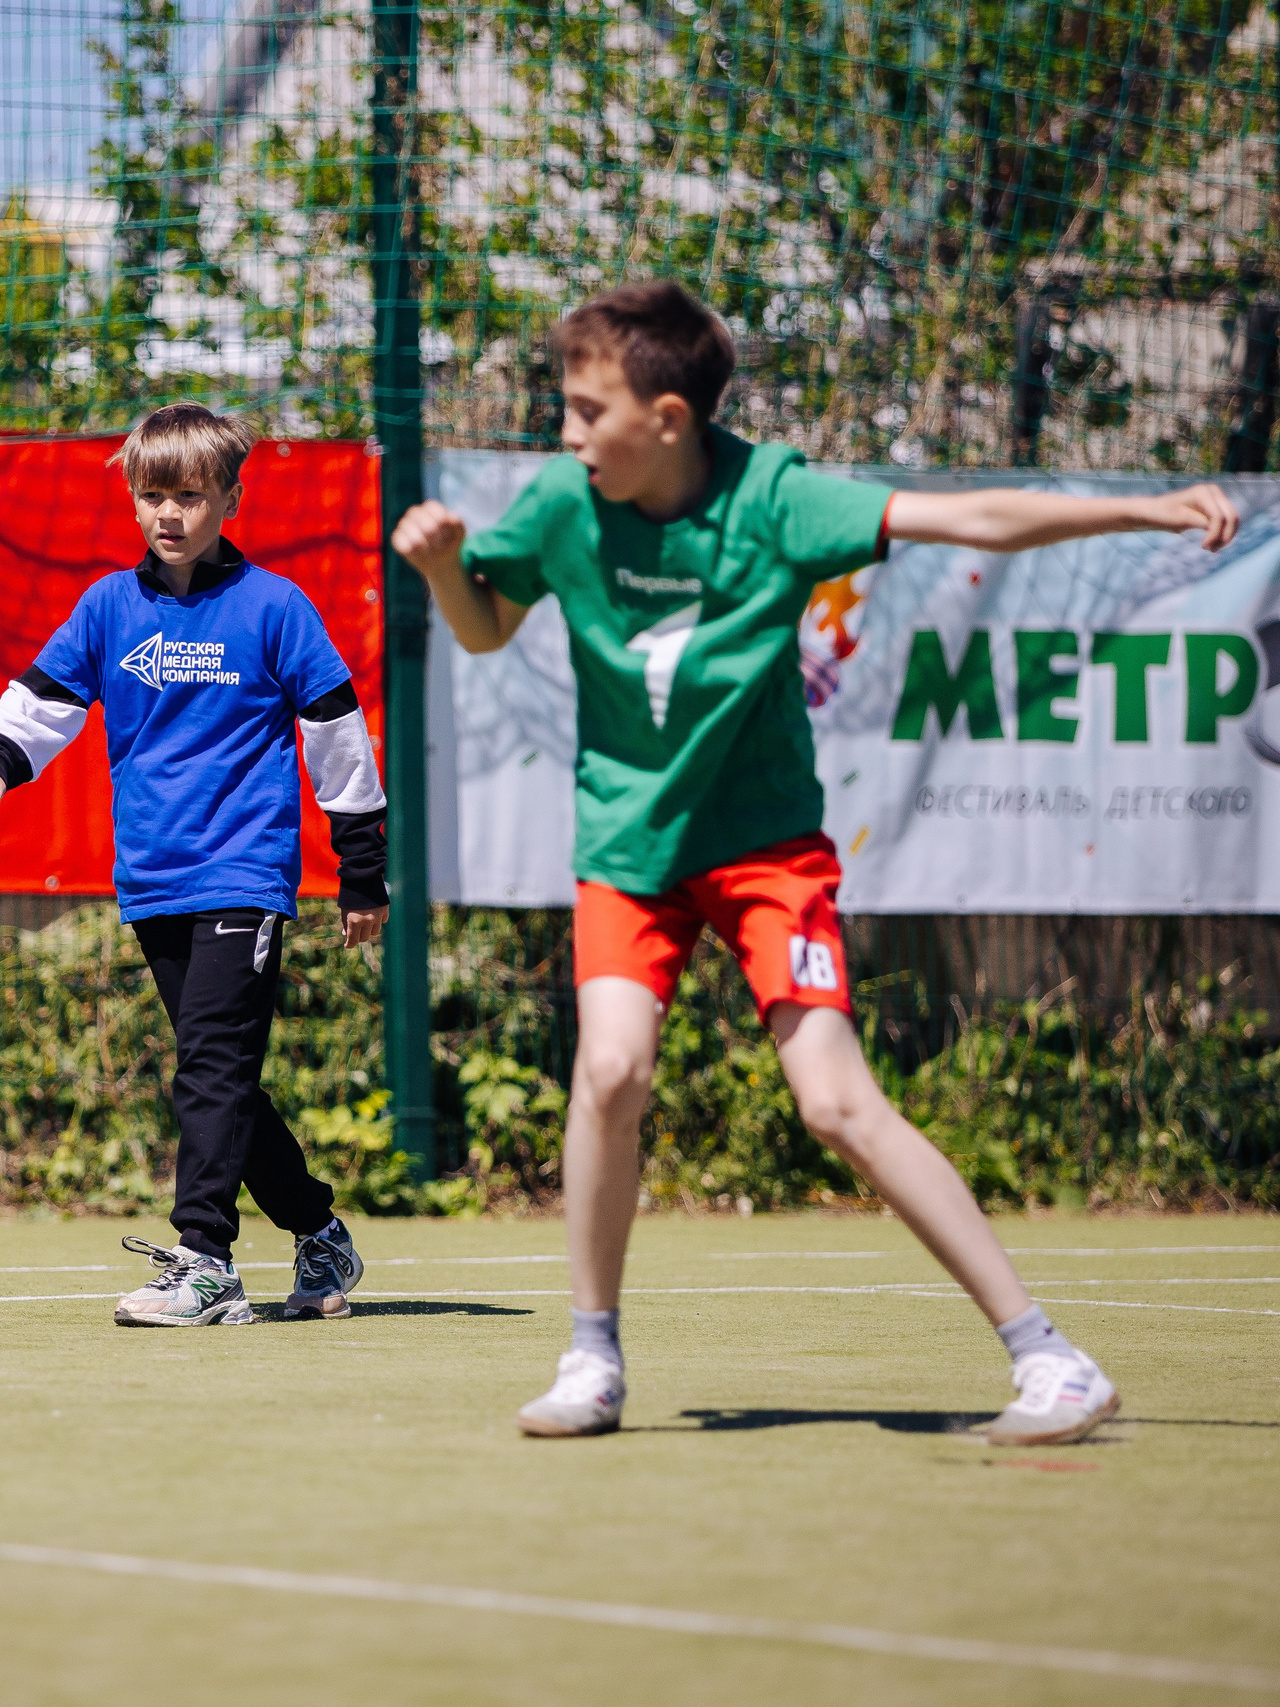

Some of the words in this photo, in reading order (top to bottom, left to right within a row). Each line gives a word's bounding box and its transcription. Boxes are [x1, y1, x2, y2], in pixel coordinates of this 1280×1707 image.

[615, 568, 703, 594] Первые
[163, 641, 225, 656] РУССКАЯ
[162, 655, 221, 669] МЕДНАЯ
[162, 669, 240, 686] КОМПАНИЯ
[914, 783, 1091, 819] ФЕСТИВАЛЬ
[1103, 784, 1254, 821] ДЕТСКОГО
